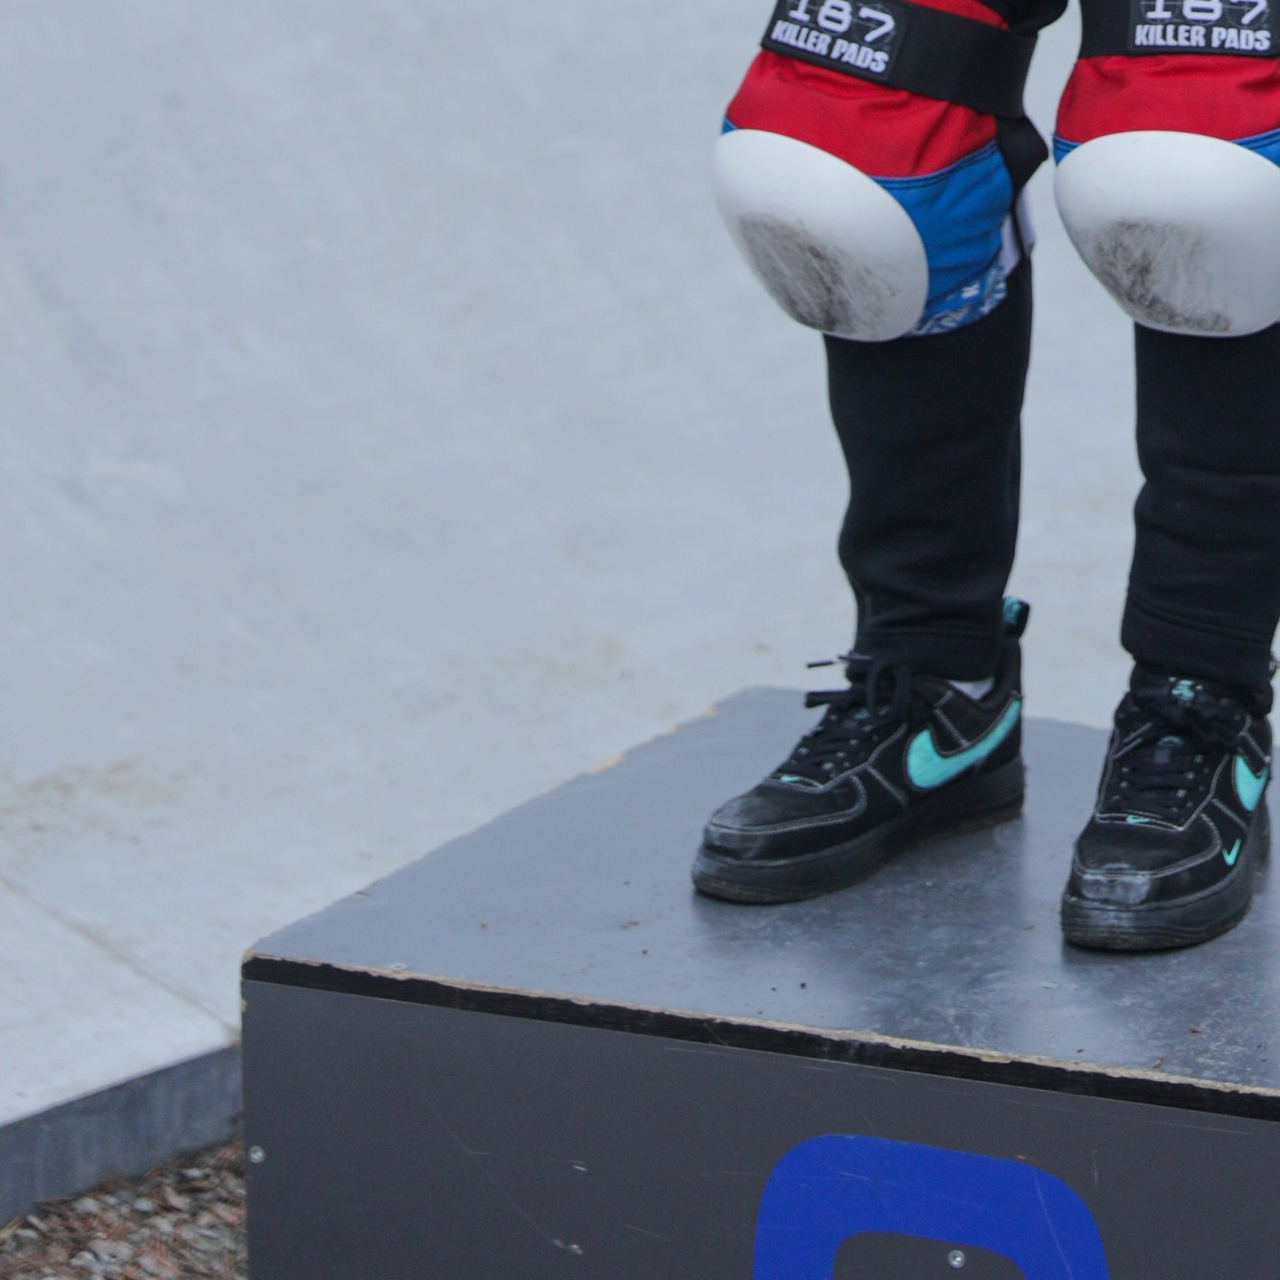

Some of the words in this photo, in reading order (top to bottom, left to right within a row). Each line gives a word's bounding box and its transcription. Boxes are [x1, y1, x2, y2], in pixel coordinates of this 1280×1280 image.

[770, 19, 832, 56] KILLER
[830, 38, 890, 73] PADS
[1134, 23, 1206, 48] KILLER
[1211, 26, 1272, 52] PADS
